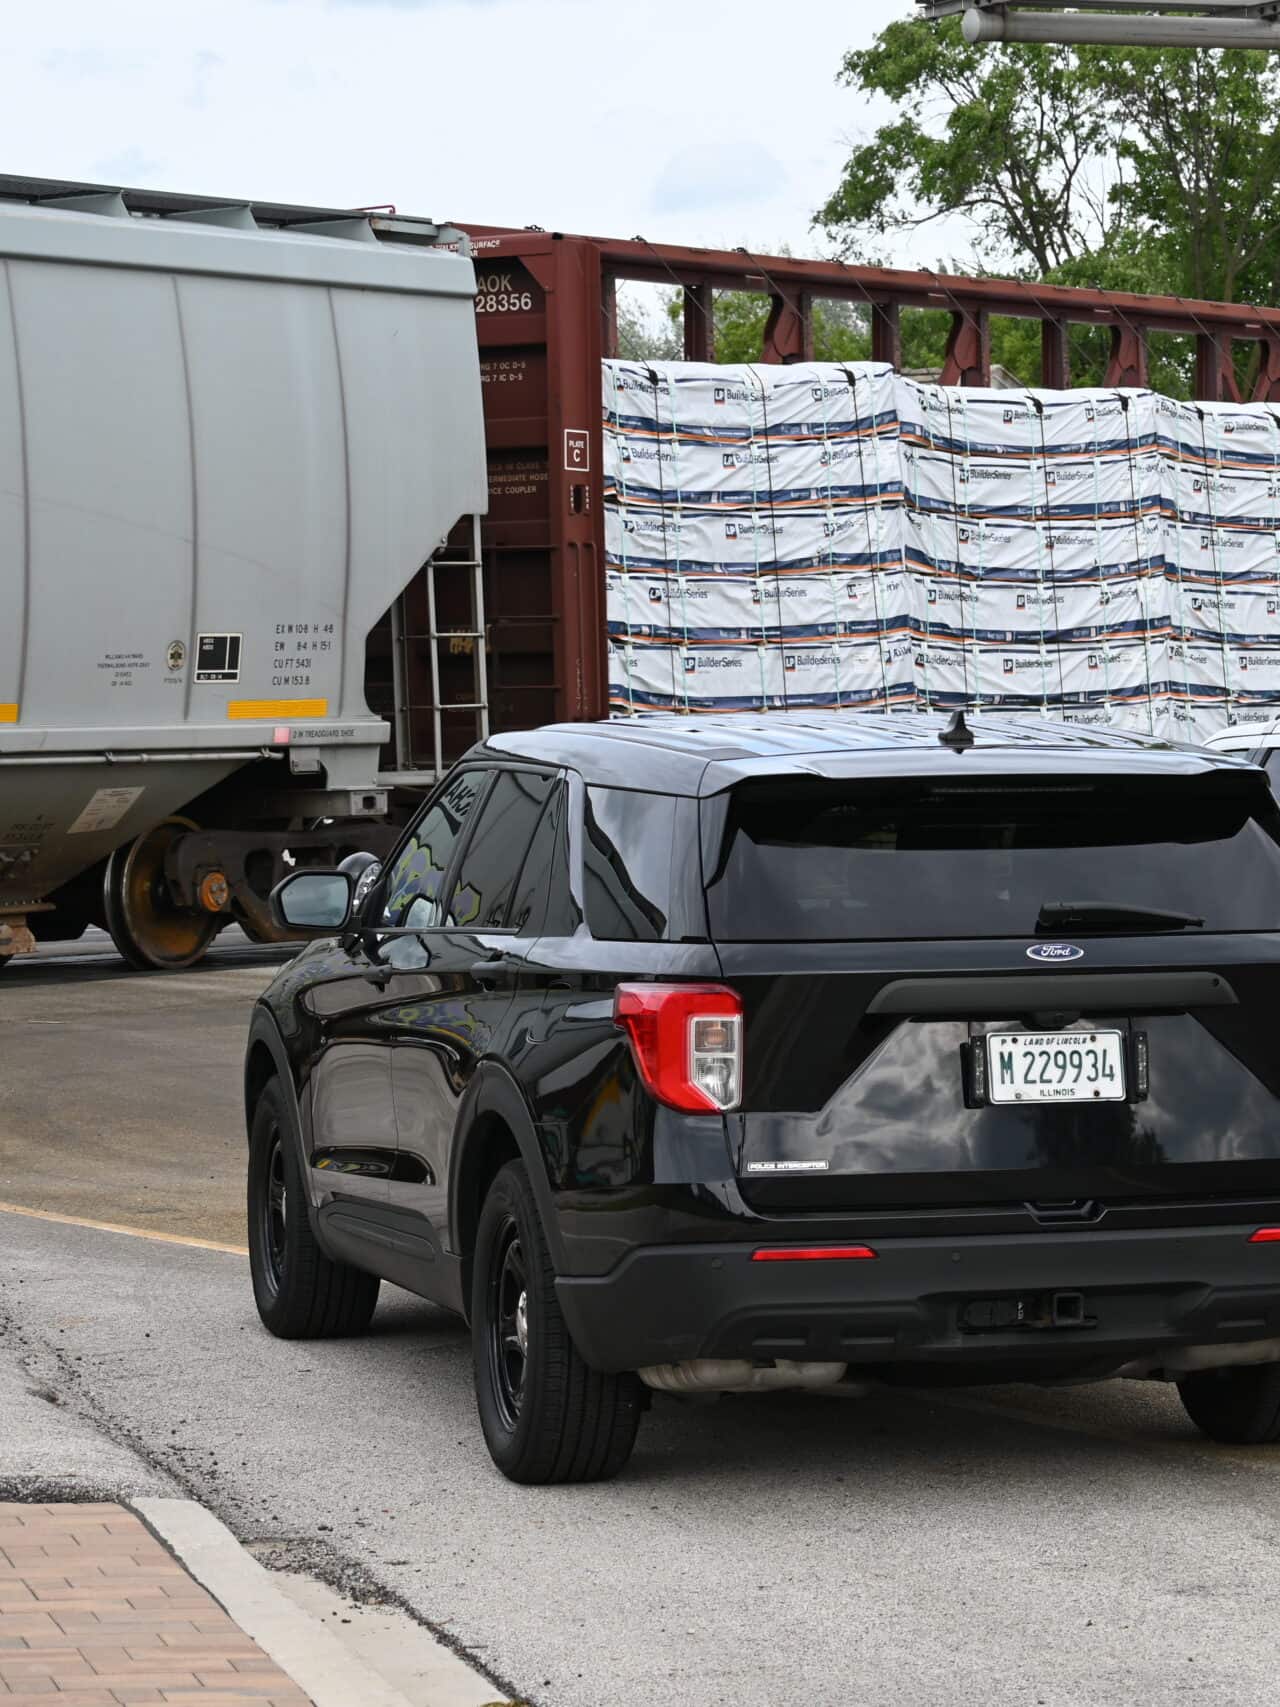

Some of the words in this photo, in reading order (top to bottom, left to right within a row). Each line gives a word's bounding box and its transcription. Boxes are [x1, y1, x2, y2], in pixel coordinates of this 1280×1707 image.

[477, 275, 512, 292] AOK
[475, 293, 532, 312] 28356
[573, 449, 580, 462] C
[505, 486, 537, 494] COUPLER
[314, 624, 318, 633] H
[312, 641, 317, 650] H
[273, 659, 283, 668] CU
[285, 659, 293, 668] FT
[697, 657, 743, 669] BuilderSeries
[272, 676, 281, 685] CU
[284, 676, 290, 685] M
[1024, 1038, 1044, 1046] LAND
[1046, 1037, 1055, 1045] OF
[1056, 1037, 1087, 1046] LINCOLN
[1022, 1047, 1115, 1085] 229934
[1039, 1088, 1076, 1097] ILLINOIS
